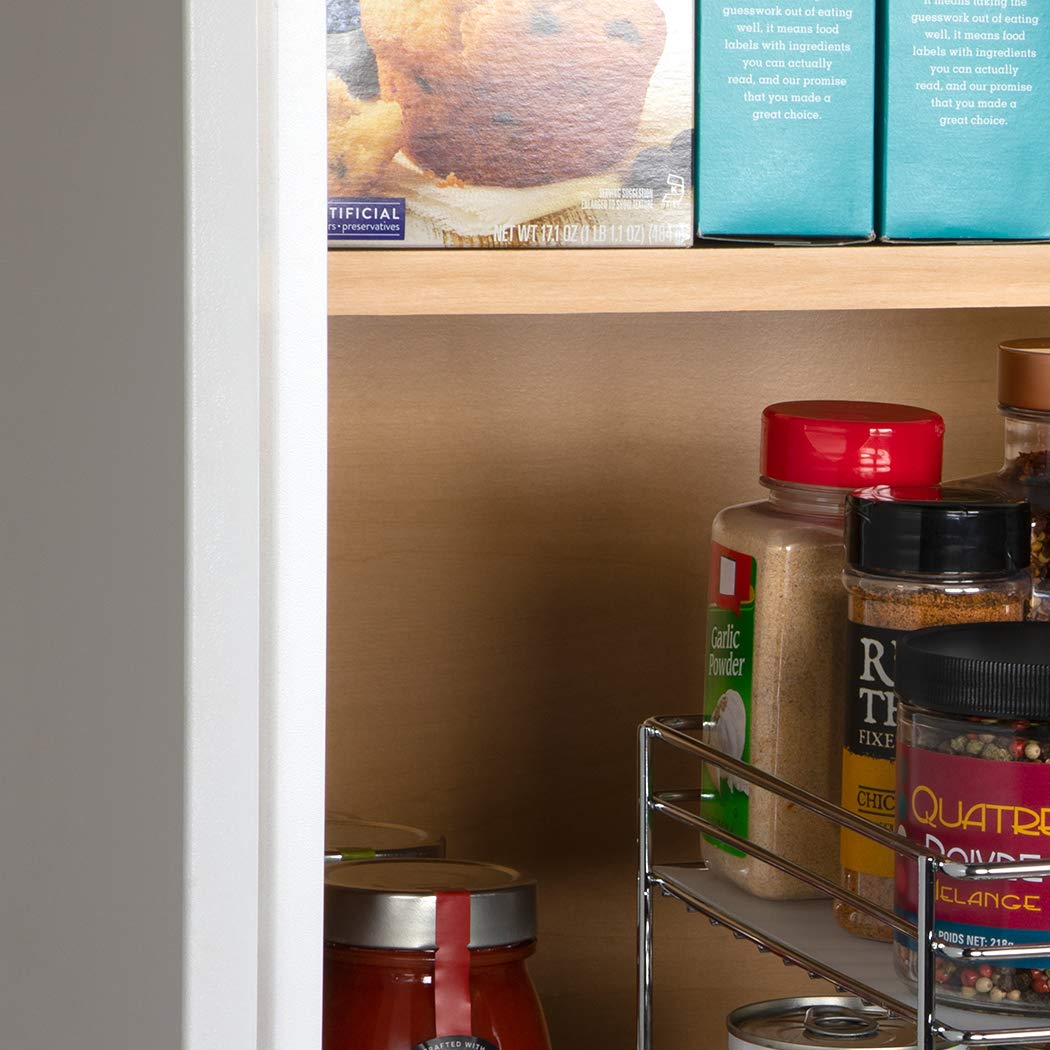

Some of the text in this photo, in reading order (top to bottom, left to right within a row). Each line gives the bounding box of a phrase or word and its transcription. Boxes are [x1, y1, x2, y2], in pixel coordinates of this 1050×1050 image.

[723, 6, 853, 19] guesswork out of eating
[911, 13, 1039, 26] guesswork out of eating
[737, 23, 839, 34] well, it means food
[925, 29, 1026, 41] well, it means food
[724, 39, 851, 53] labels with ingredients
[912, 46, 1037, 59] labels with ingredients
[742, 58, 832, 71] you can actually
[930, 64, 1019, 77] you can actually
[727, 74, 847, 88] read, and our promise
[915, 80, 1033, 93] read, and our promise
[744, 92, 831, 104] that you made a
[931, 98, 1017, 110] that you made a
[752, 109, 822, 121] great choice.
[940, 115, 1008, 126] great choice.
[329, 207, 400, 219] TIFICIAL
[342, 221, 400, 233] preservatives
[493, 225, 515, 242] NET
[517, 225, 538, 242] WT
[541, 225, 560, 242] 17.1
[563, 226, 578, 242] OZ
[593, 226, 606, 242] LB
[610, 226, 623, 242] 1.1
[627, 225, 645, 244] OZ)
[711, 625, 740, 650] Garlic
[708, 651, 745, 677] Powder
[857, 790, 895, 811] CHIC
[938, 931, 964, 945] POIDS
[966, 935, 987, 947] NET:
